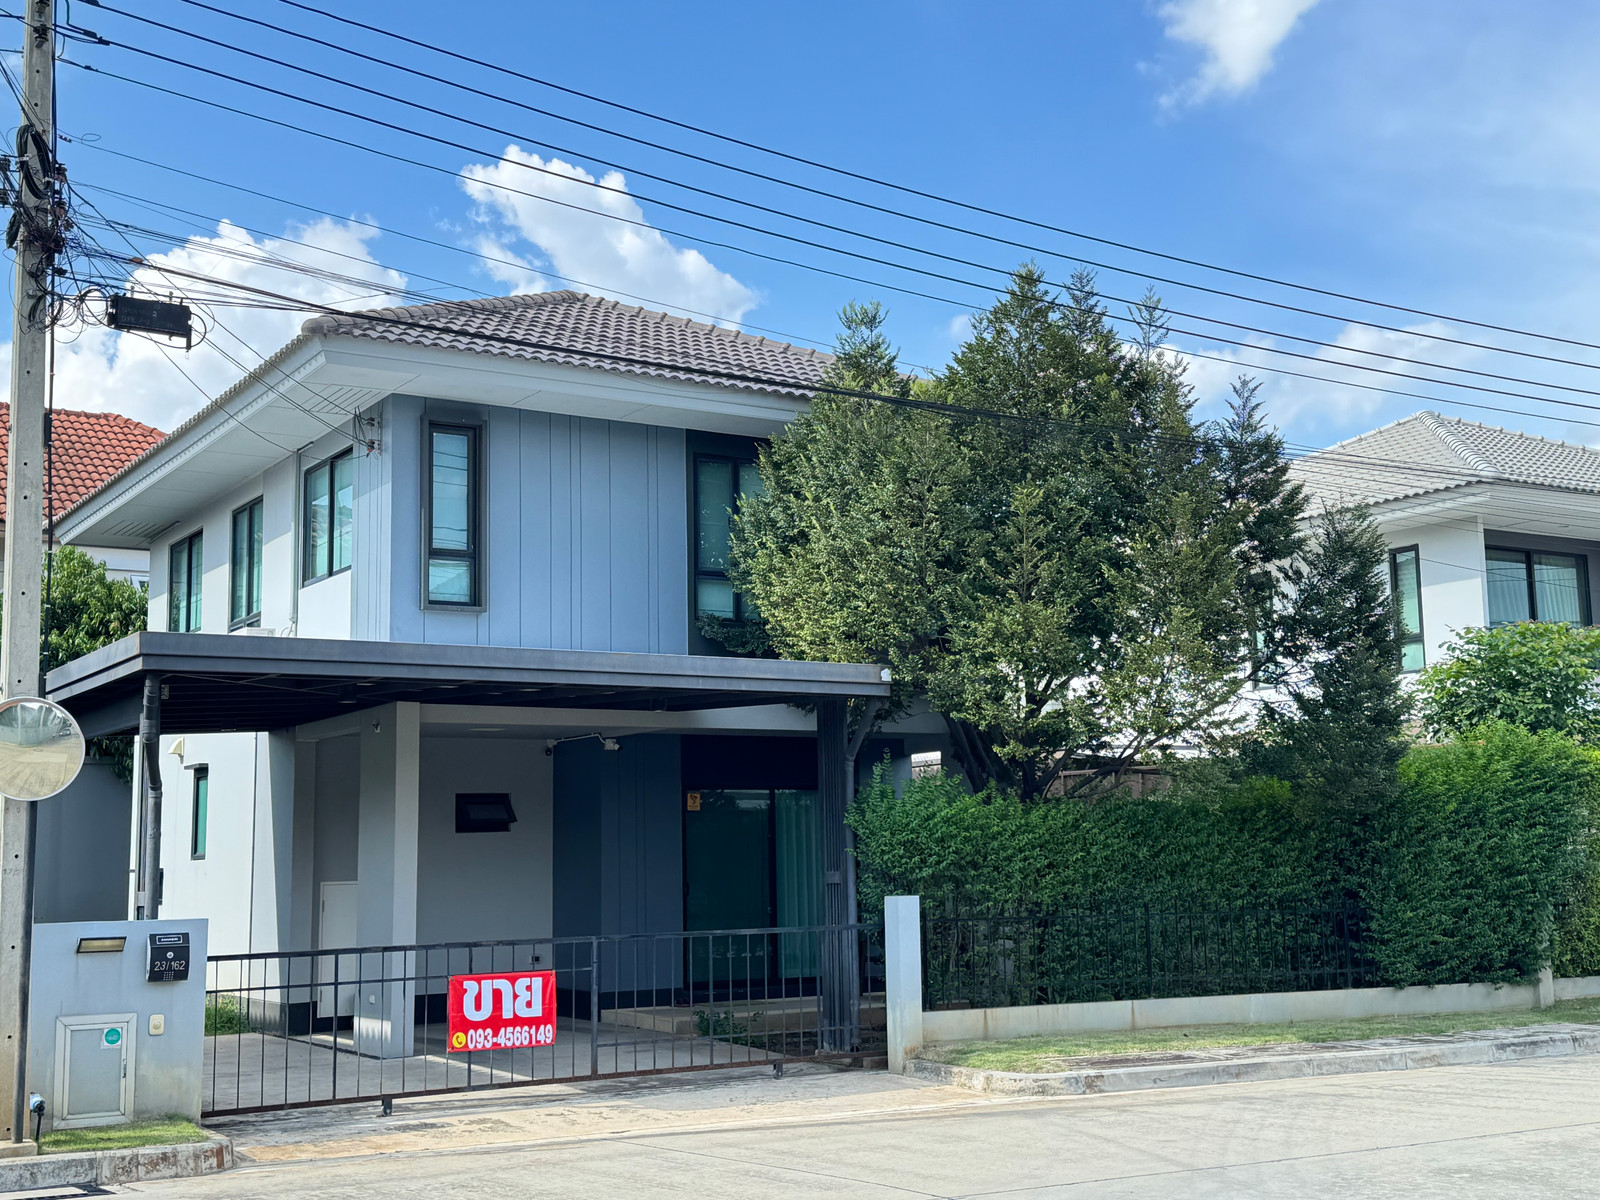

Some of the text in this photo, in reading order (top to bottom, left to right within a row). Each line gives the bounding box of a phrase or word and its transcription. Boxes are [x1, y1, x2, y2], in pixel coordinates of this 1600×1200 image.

[154, 960, 186, 971] 23/162
[463, 977, 543, 1021] ขาย
[467, 1024, 553, 1049] 093-4566149
